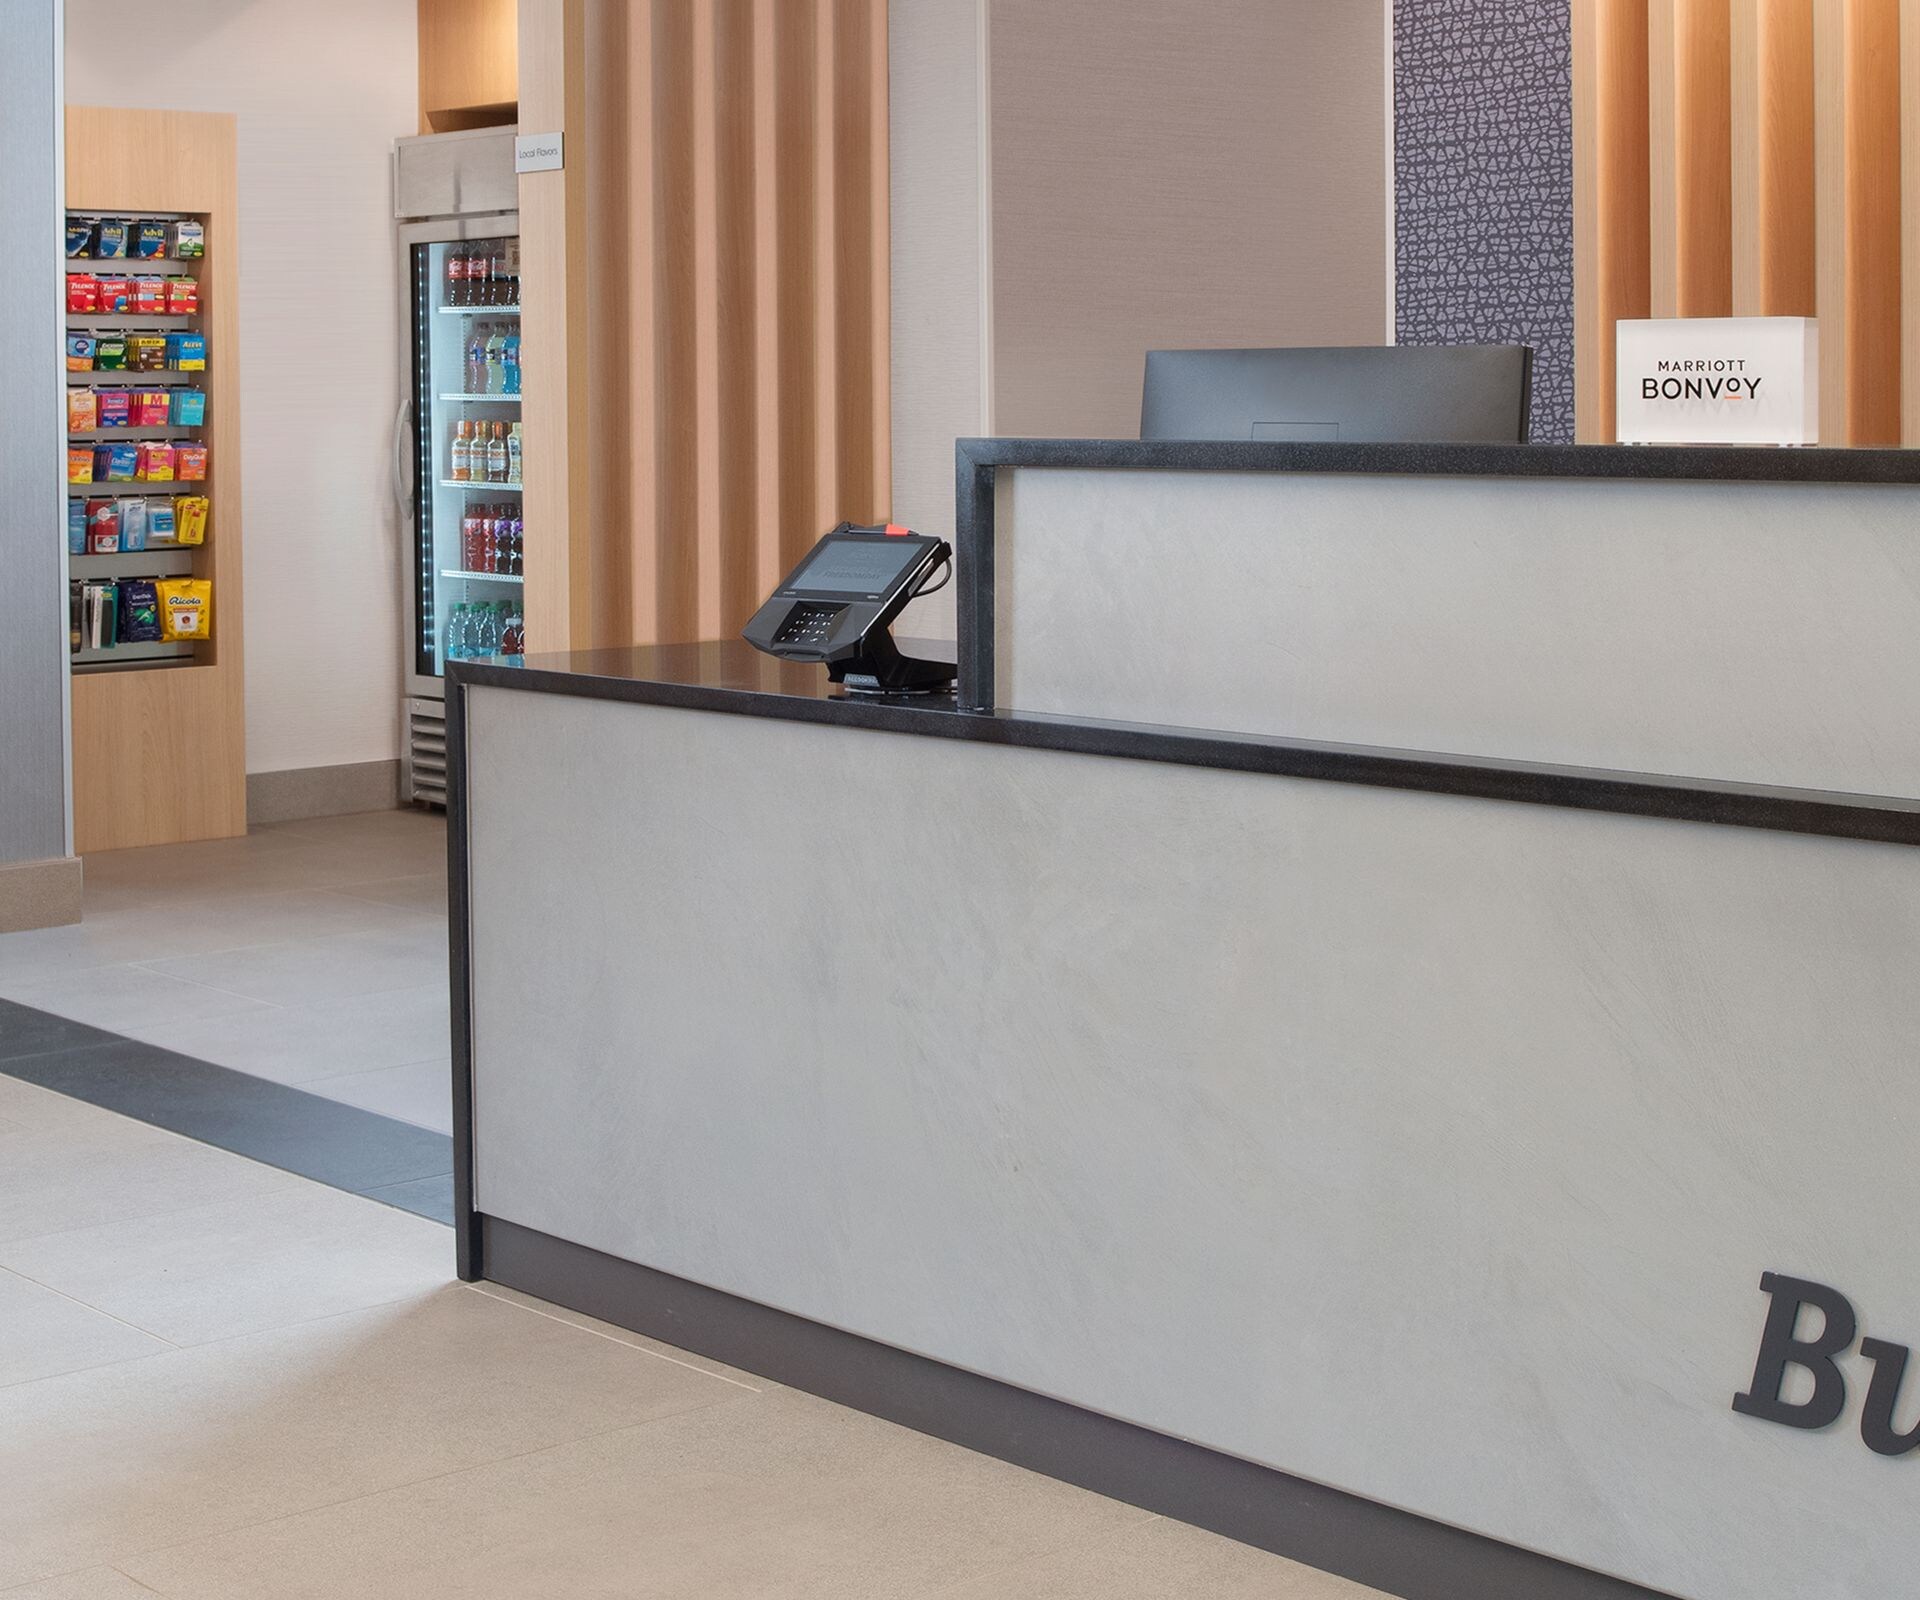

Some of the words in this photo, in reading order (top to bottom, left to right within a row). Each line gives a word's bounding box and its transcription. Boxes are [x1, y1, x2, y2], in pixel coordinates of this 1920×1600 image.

[143, 228, 164, 237] Advil
[1657, 359, 1747, 373] MARRIOTT
[1642, 377, 1762, 400] BONVOY
[168, 595, 203, 606] Ricola
